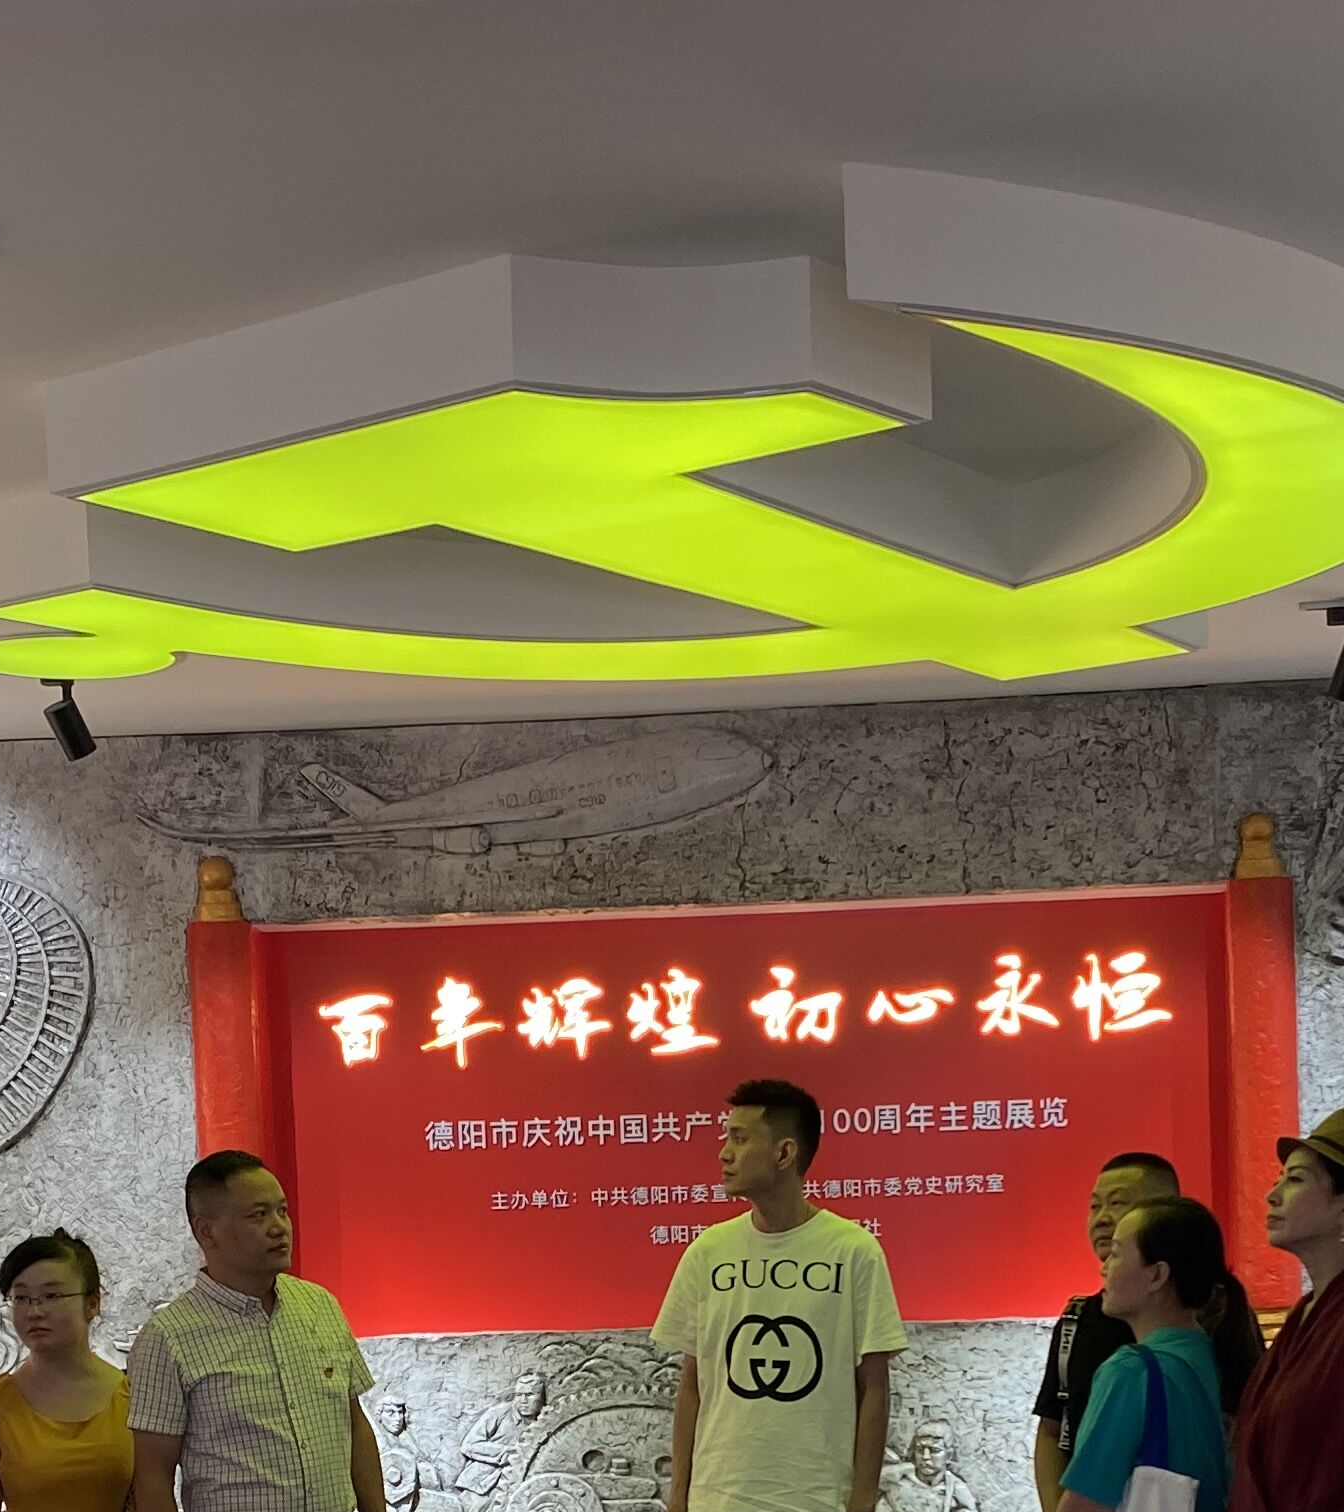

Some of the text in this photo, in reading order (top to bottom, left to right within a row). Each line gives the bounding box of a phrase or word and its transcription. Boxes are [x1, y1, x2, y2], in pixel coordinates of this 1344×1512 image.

[802, 1174, 1005, 1200] 共德阳市委党史研究室
[711, 1259, 844, 1294] GUCCI
